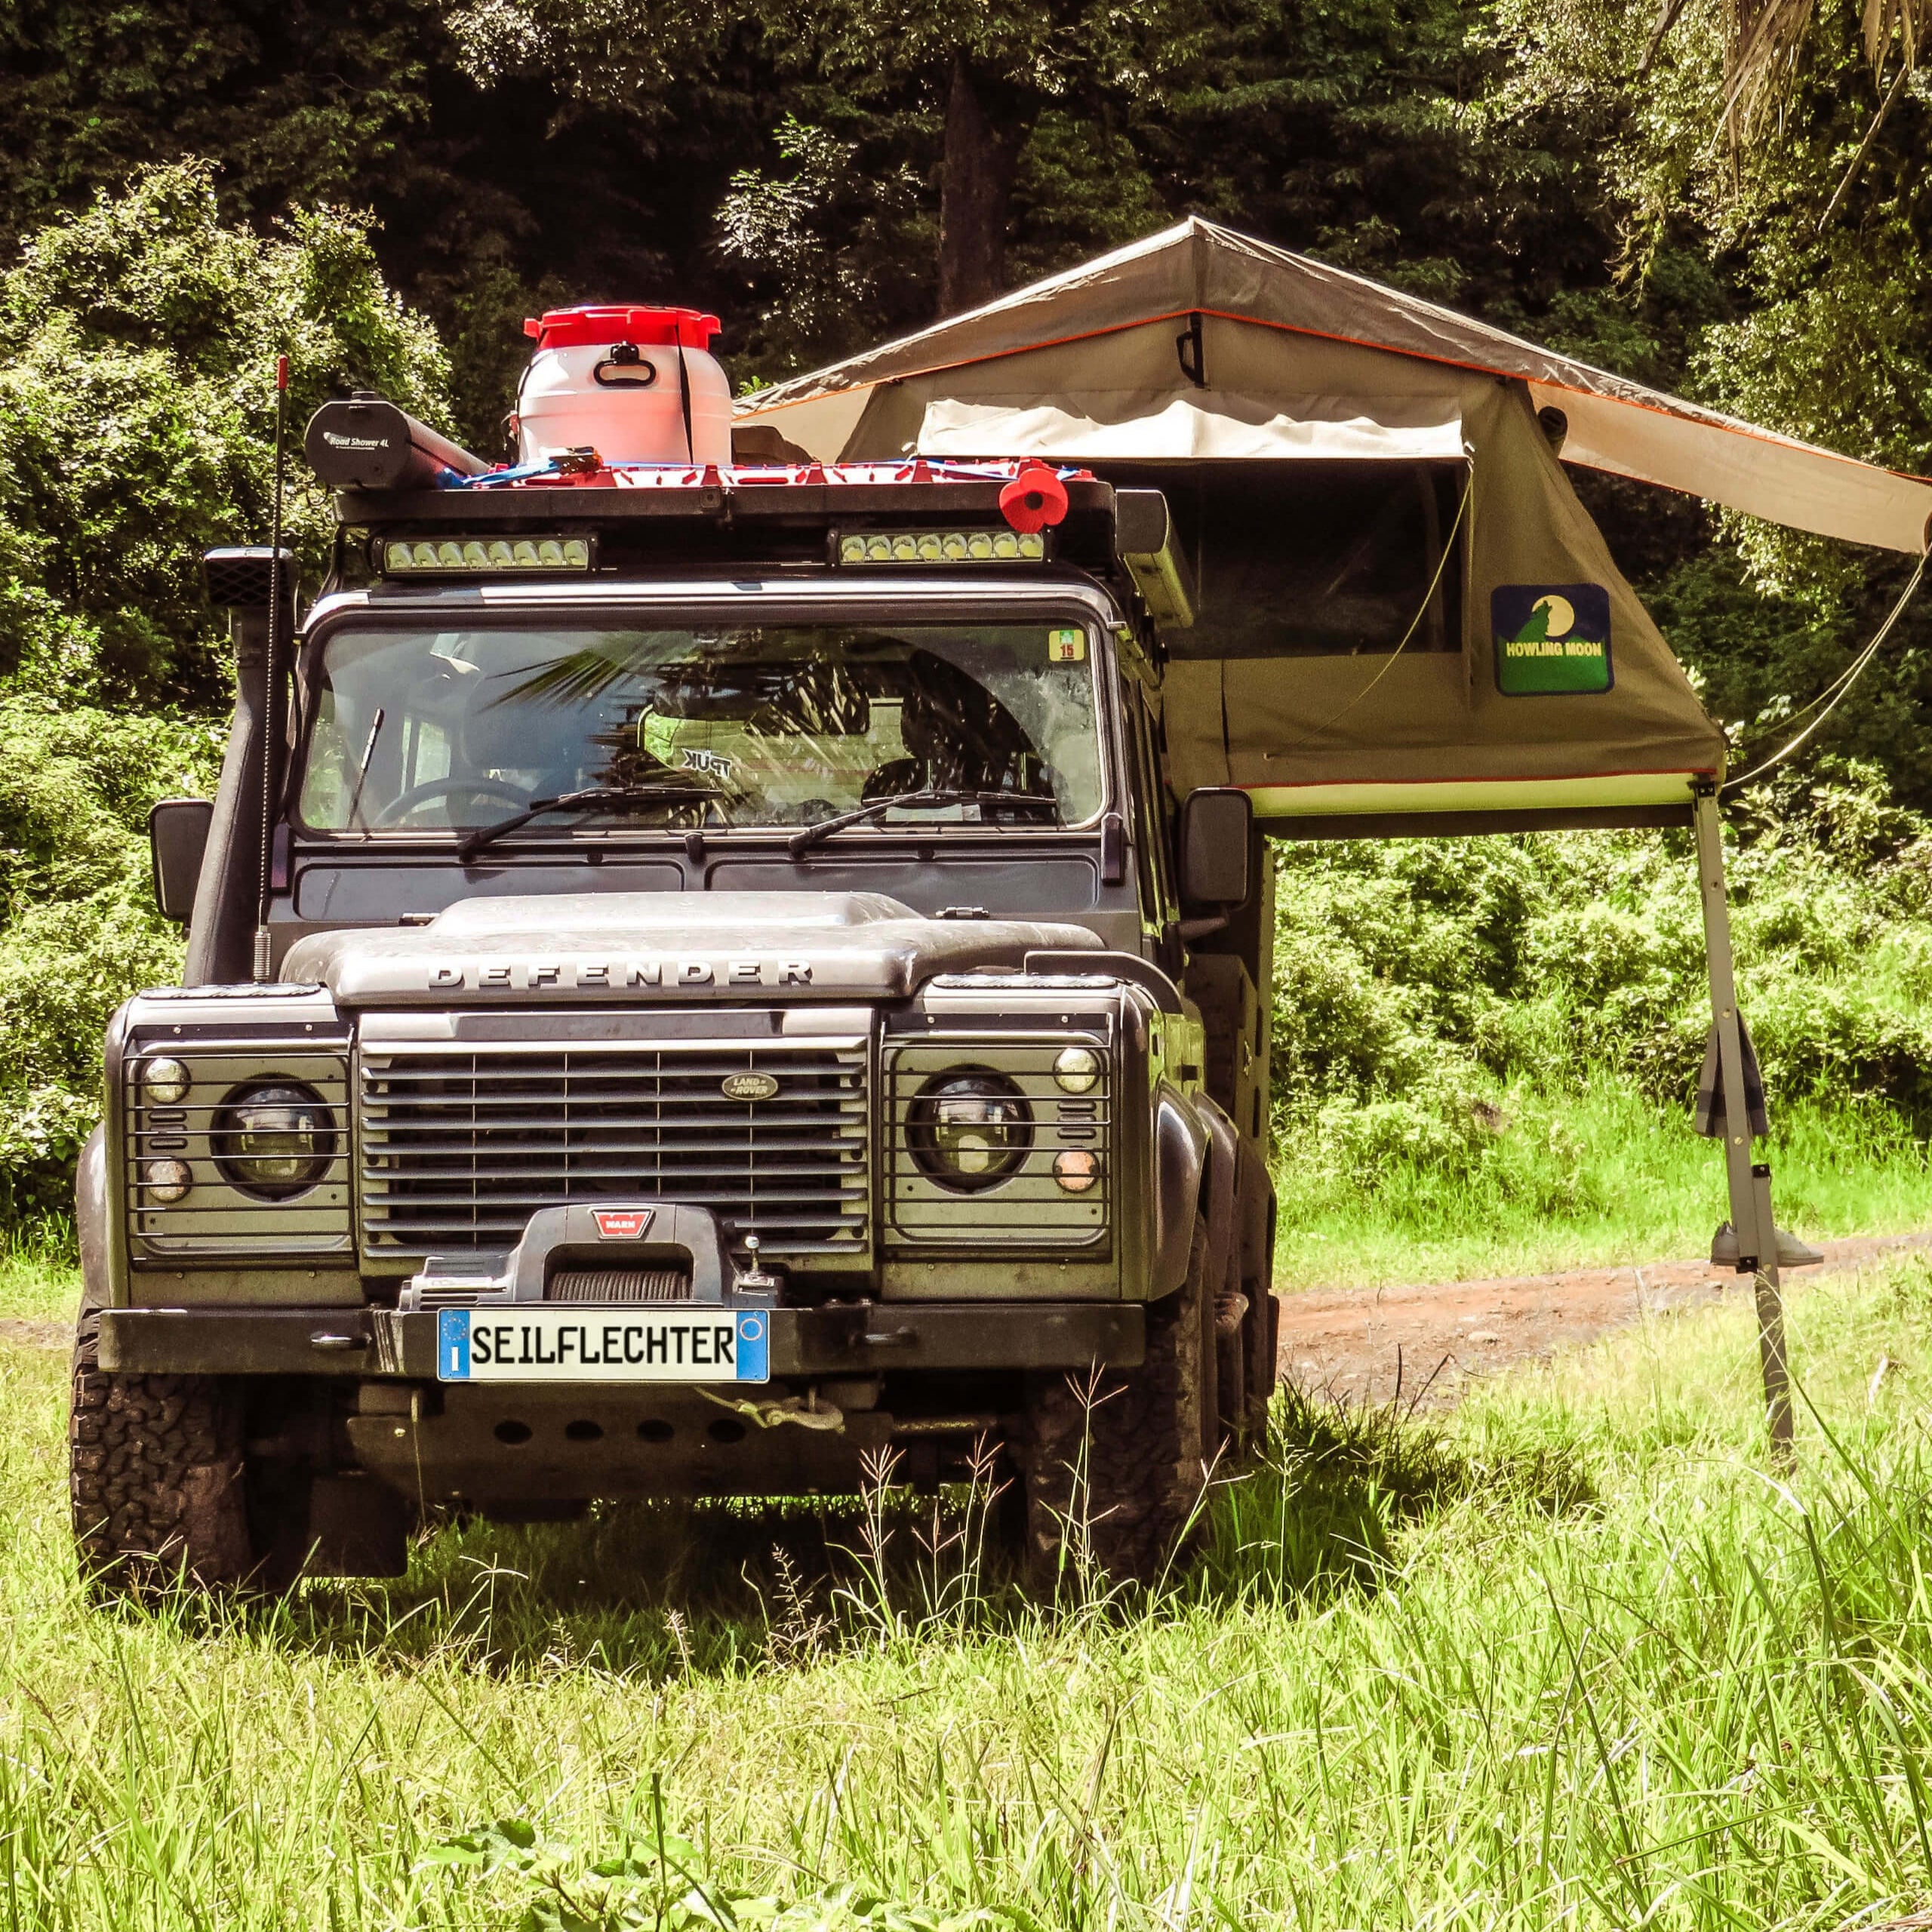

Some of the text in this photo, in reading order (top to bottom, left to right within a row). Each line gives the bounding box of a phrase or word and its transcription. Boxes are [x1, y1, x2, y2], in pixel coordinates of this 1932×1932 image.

[331, 437, 350, 445] Road
[351, 438, 379, 446] Shower
[1060, 645, 1074, 657] 15
[1506, 641, 1601, 657] HOWLING MOON
[428, 960, 813, 987] DEFENDER
[605, 1220, 636, 1229] WARN
[471, 1326, 734, 1364] SEILFLECHTER
